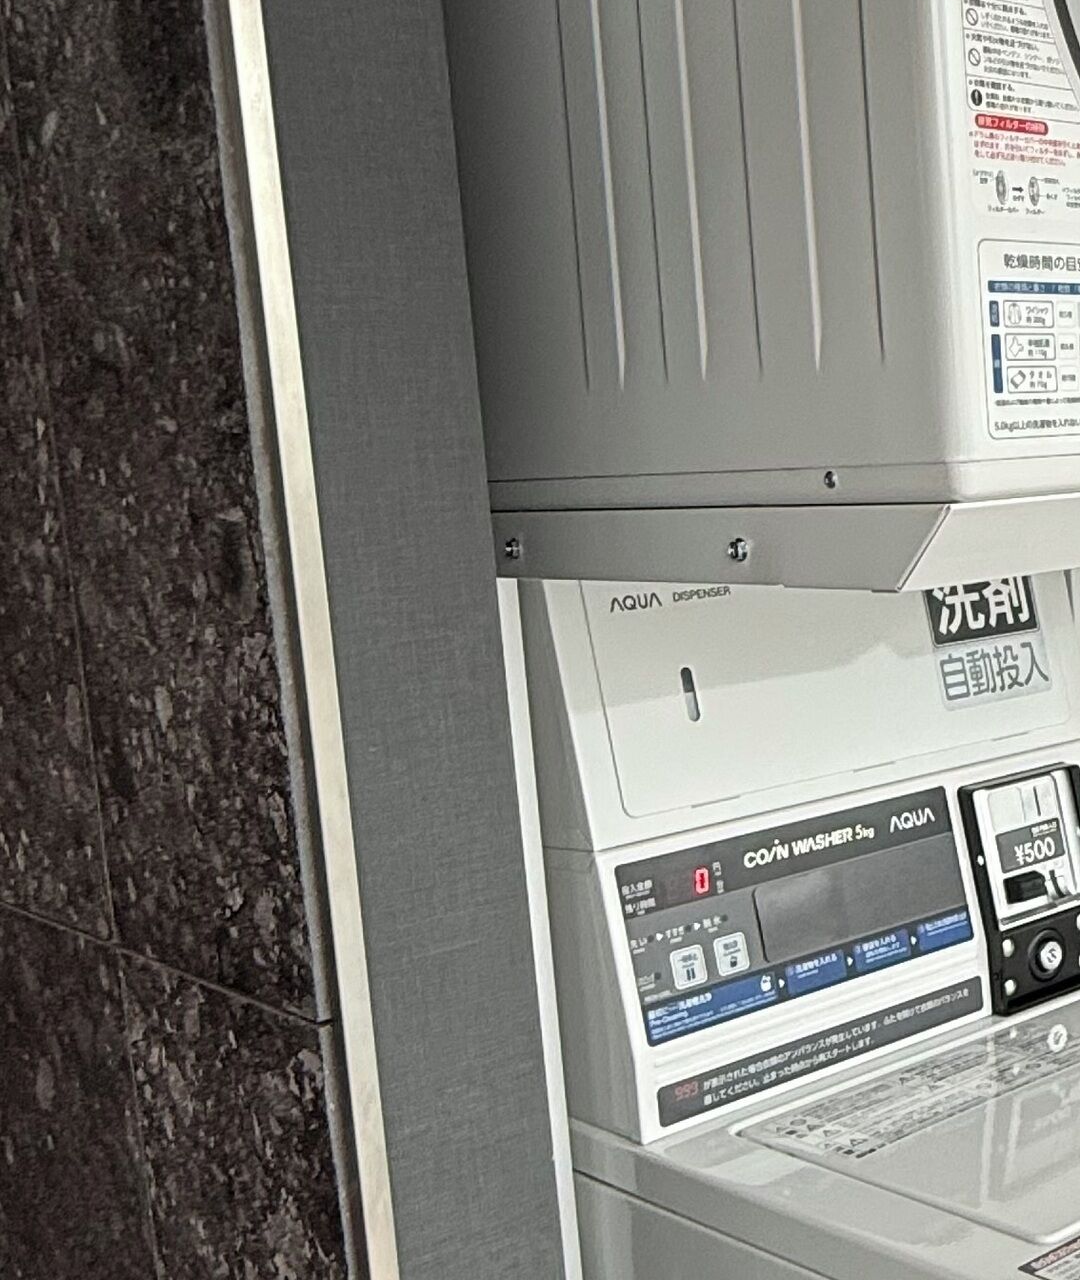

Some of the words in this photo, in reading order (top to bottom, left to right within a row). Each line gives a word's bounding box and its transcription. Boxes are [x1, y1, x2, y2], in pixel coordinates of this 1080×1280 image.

[610, 592, 662, 613] AQUA
[672, 586, 731, 602] DISPENSER
[932, 577, 1030, 635] 洗剤
[940, 642, 1049, 701] 自動投入
[791, 827, 854, 857] WASHER
[854, 824, 875, 841] 5kg
[889, 807, 935, 833] AQUA
[1014, 836, 1056, 865] ¥500
